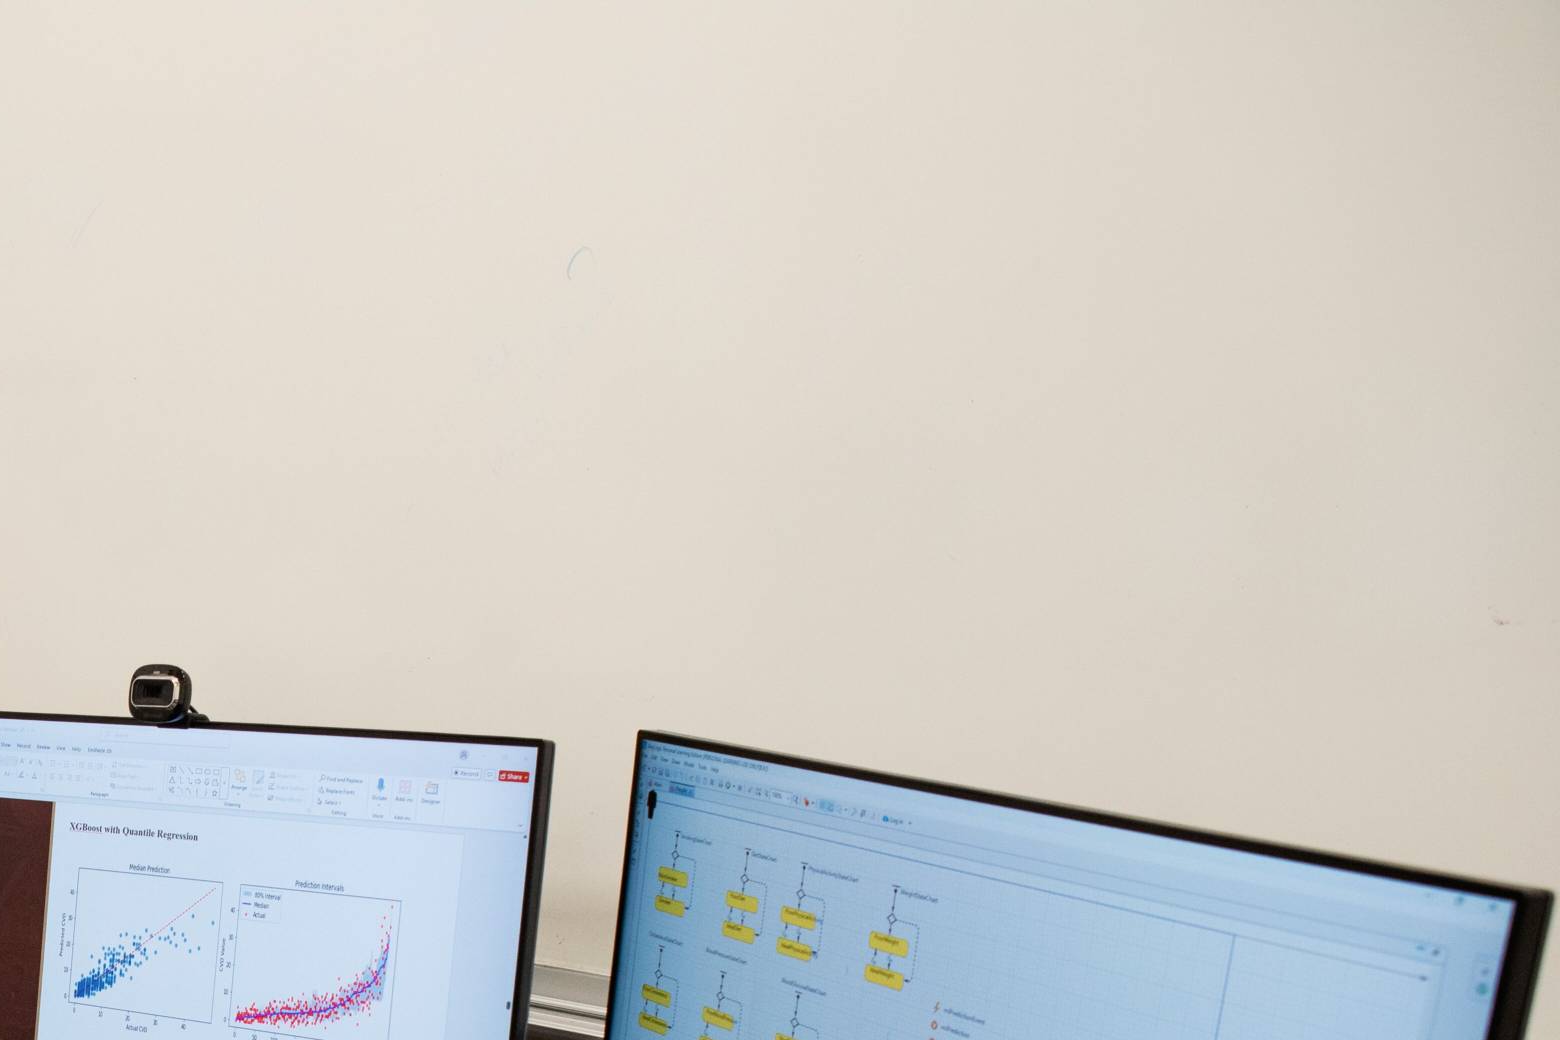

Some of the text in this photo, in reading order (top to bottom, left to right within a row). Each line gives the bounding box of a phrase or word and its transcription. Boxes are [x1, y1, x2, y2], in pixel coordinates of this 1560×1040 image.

[69, 821, 199, 841] XGBoost with Quantile Regression
